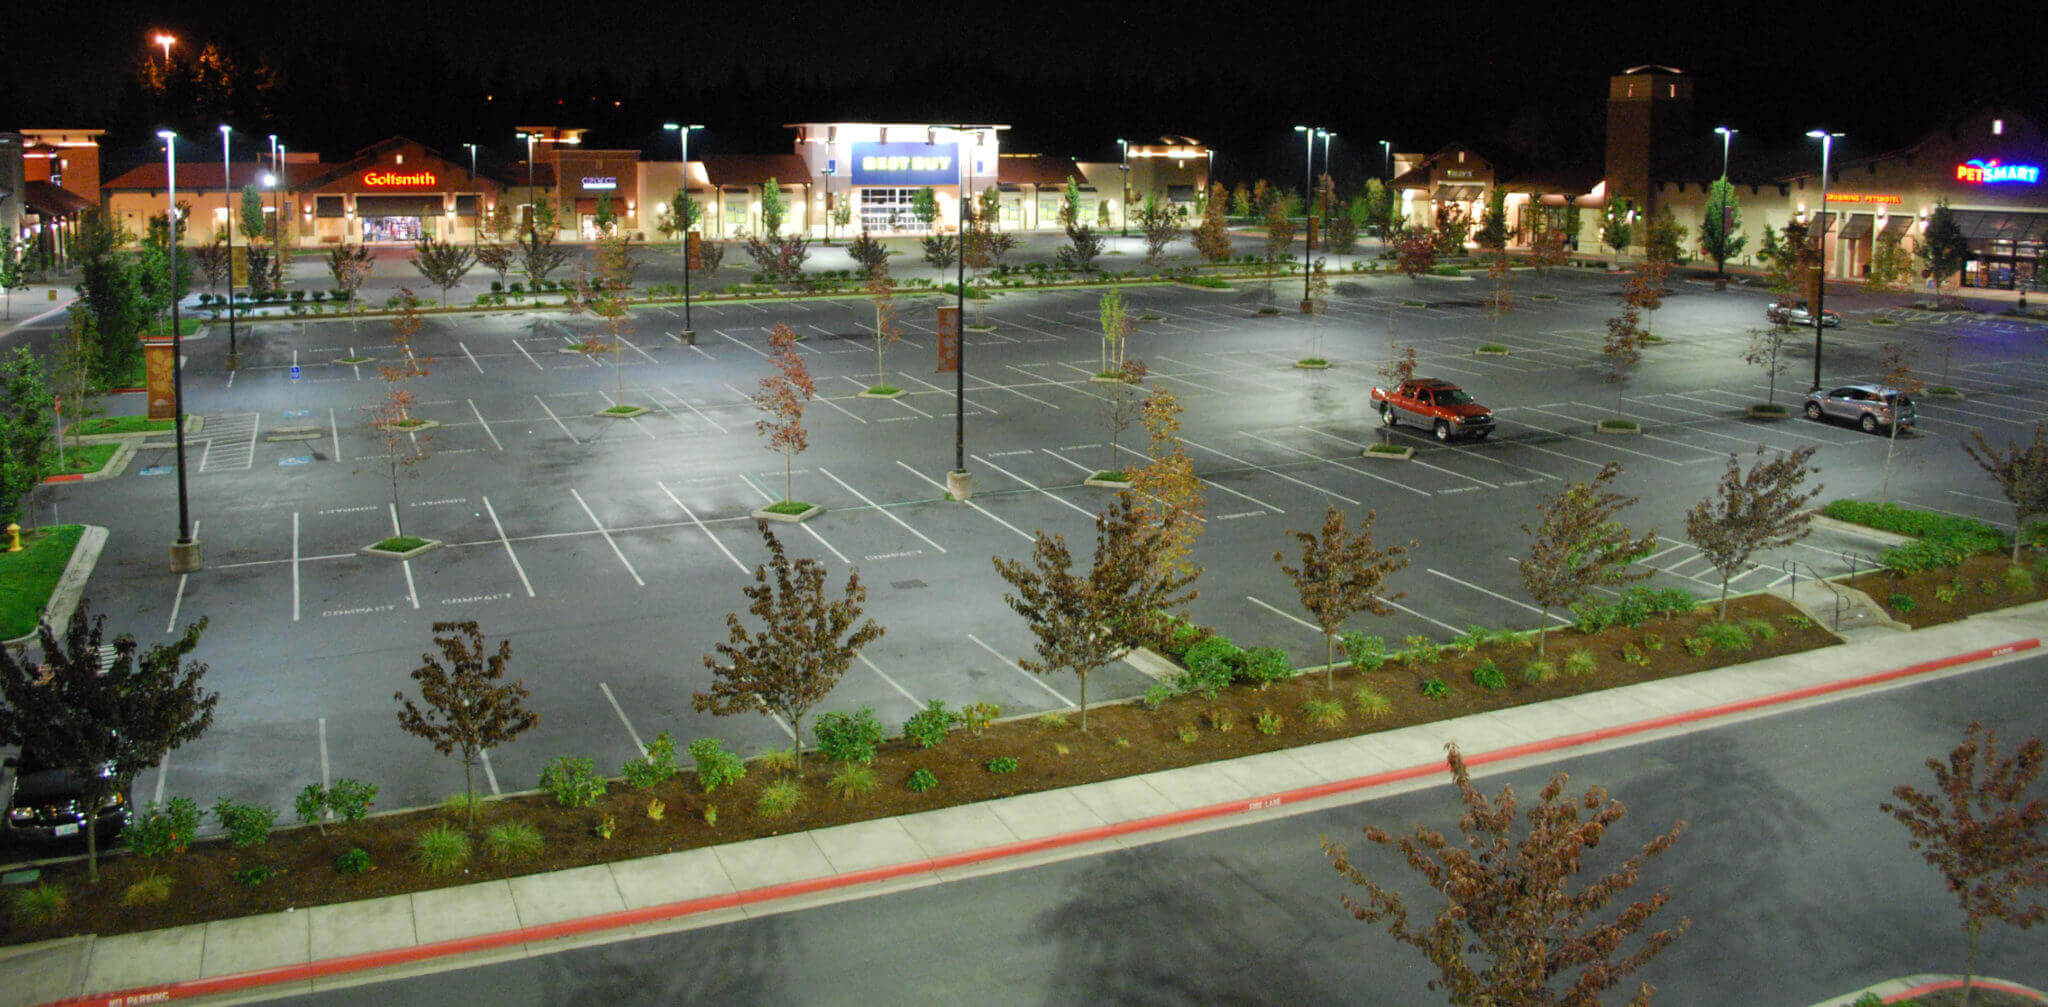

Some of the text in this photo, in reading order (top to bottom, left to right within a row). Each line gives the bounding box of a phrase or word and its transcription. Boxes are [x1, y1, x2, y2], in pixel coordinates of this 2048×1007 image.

[862, 156, 952, 170] BEST BUY
[364, 171, 436, 186] Golfsmith
[1957, 163, 2039, 182] PETSMART
[441, 592, 512, 605] COMPACT
[322, 604, 396, 617] COMPACT
